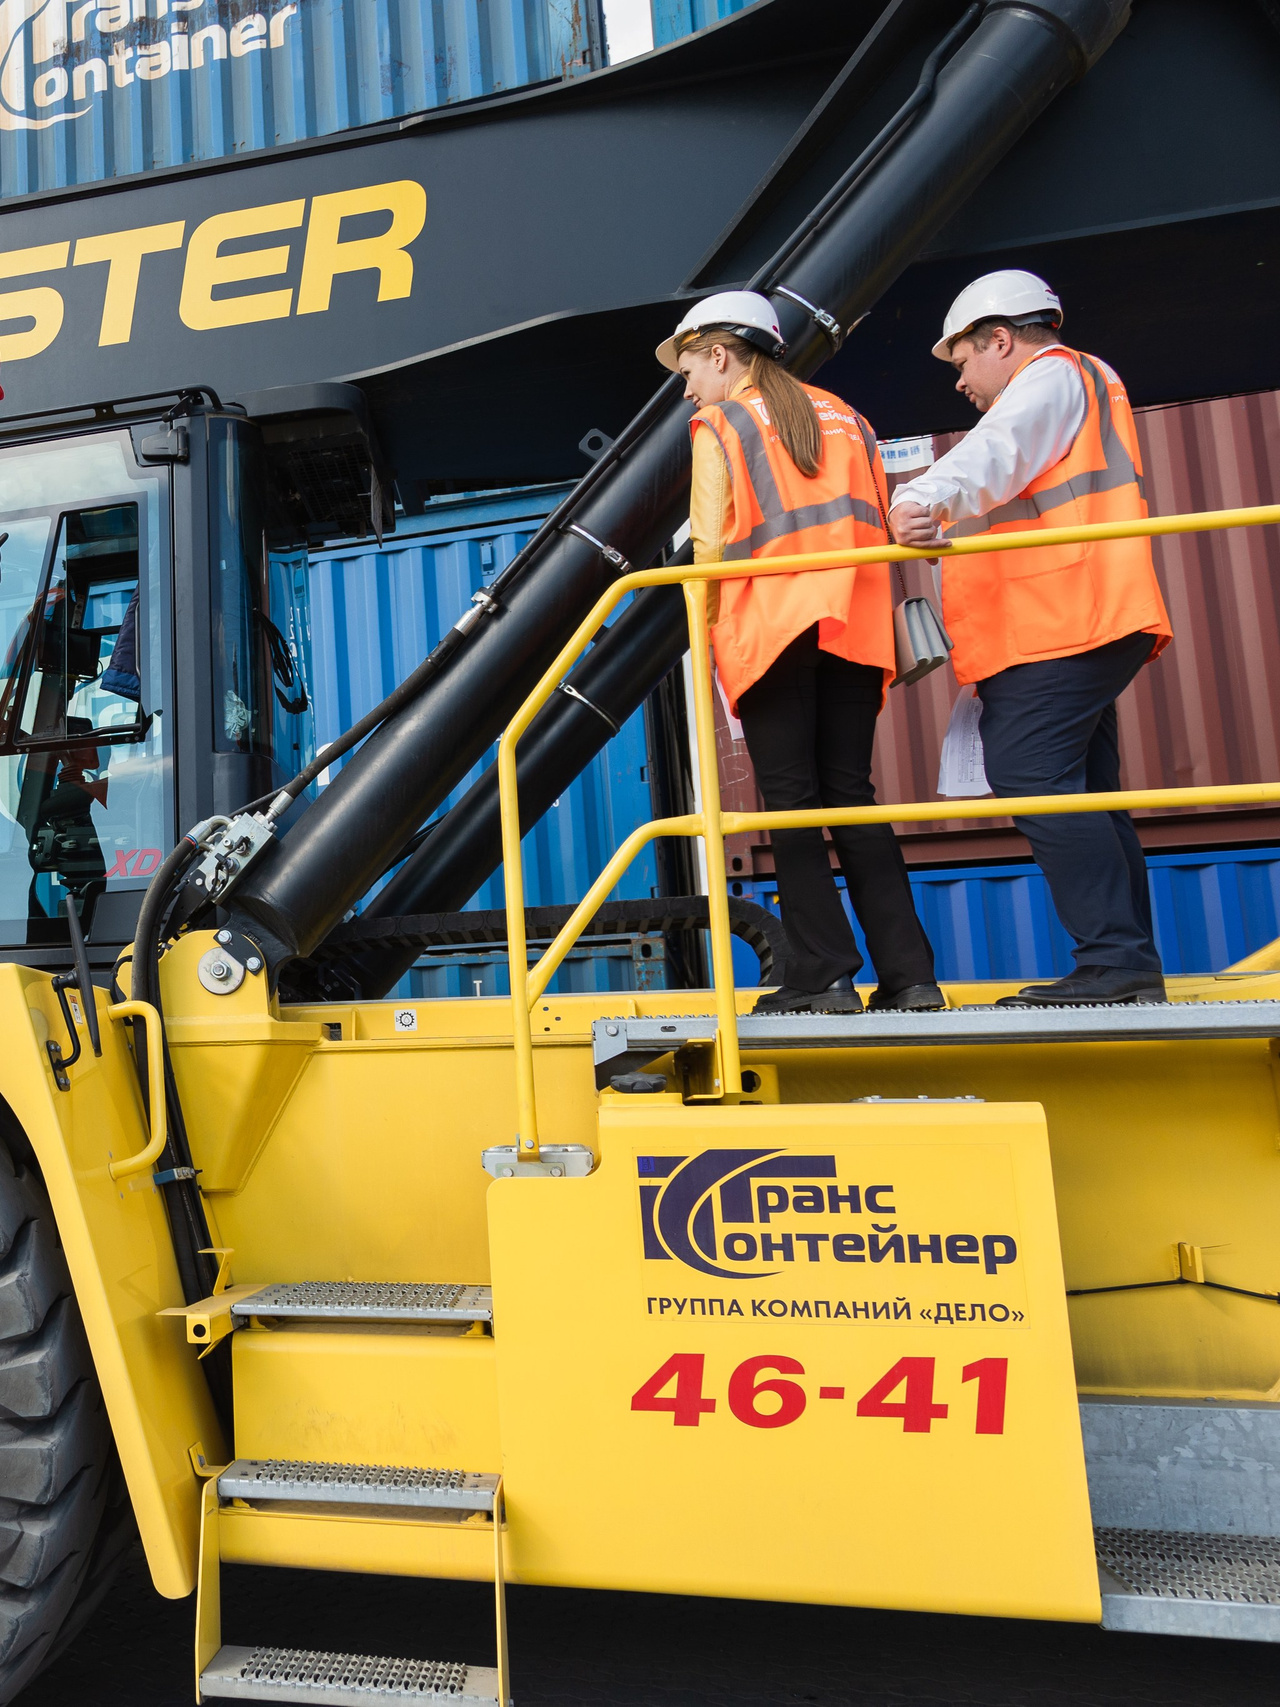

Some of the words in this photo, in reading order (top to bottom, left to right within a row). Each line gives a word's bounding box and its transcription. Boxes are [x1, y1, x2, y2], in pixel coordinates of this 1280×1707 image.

[102, 848, 163, 877] XD
[720, 1154, 898, 1225] Транс
[647, 1296, 744, 1318] ГРУППА
[751, 1296, 912, 1321] КОМПАНИЙ
[919, 1303, 1025, 1326] «ДЕЛО»
[631, 1353, 1009, 1435] 46-41
